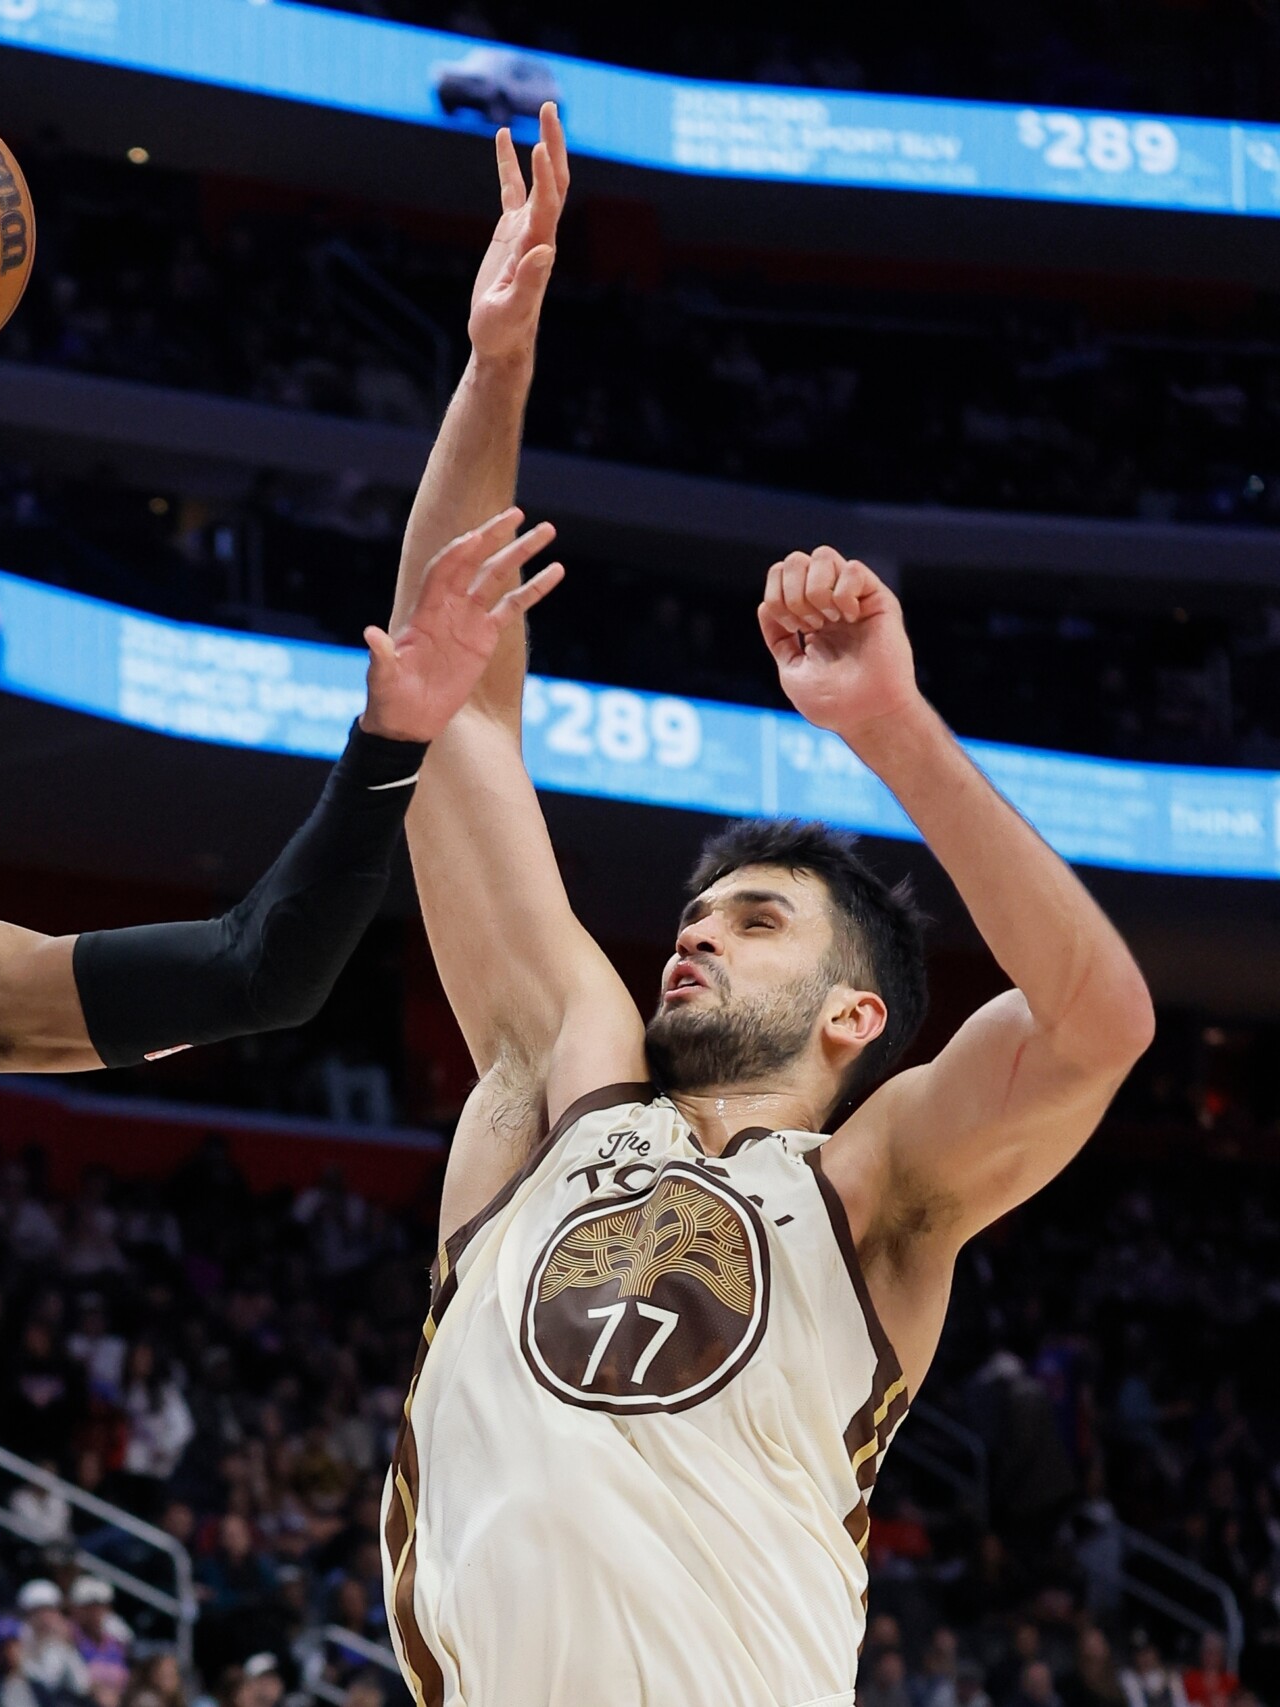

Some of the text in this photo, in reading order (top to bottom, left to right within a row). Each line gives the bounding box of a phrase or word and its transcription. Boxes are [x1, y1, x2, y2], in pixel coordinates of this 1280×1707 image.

[1016, 109, 1179, 175] $289
[598, 1130, 651, 1159] The
[580, 1301, 680, 1387] 77
